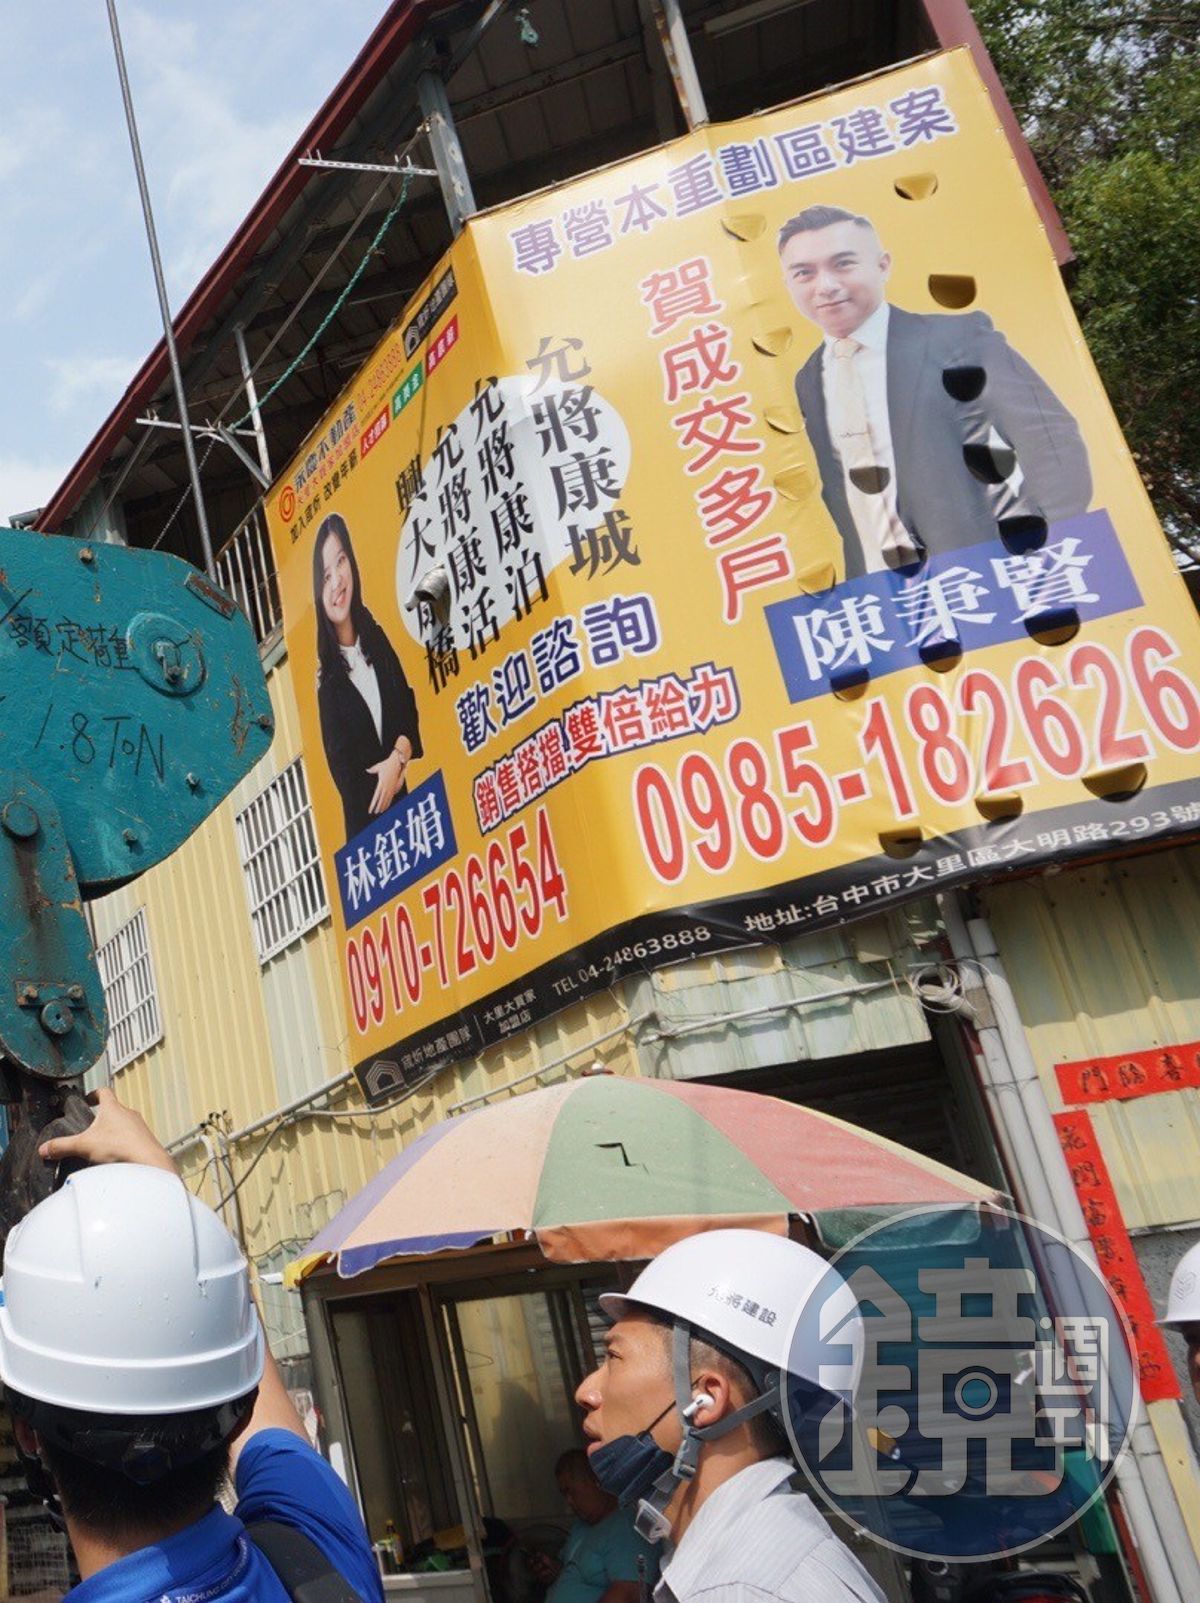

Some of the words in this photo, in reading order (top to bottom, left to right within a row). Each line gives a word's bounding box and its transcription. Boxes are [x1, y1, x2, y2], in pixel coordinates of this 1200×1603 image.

[511, 87, 955, 273] 專營本重劃區建案
[432, 423, 500, 661] 允將康活
[471, 376, 550, 622] 允將康泊
[526, 336, 641, 580] 允將康城
[641, 258, 790, 620] 賀成交多戶
[457, 596, 658, 752] 歡迎諮詢
[792, 537, 1100, 681] 陳秉賢
[344, 792, 445, 911] 林鈺娟
[636, 628, 1200, 882] 0985-182626
[346, 808, 566, 1032] 0910-726654
[552, 978, 579, 997] TEL
[578, 926, 711, 984] 04-24863888
